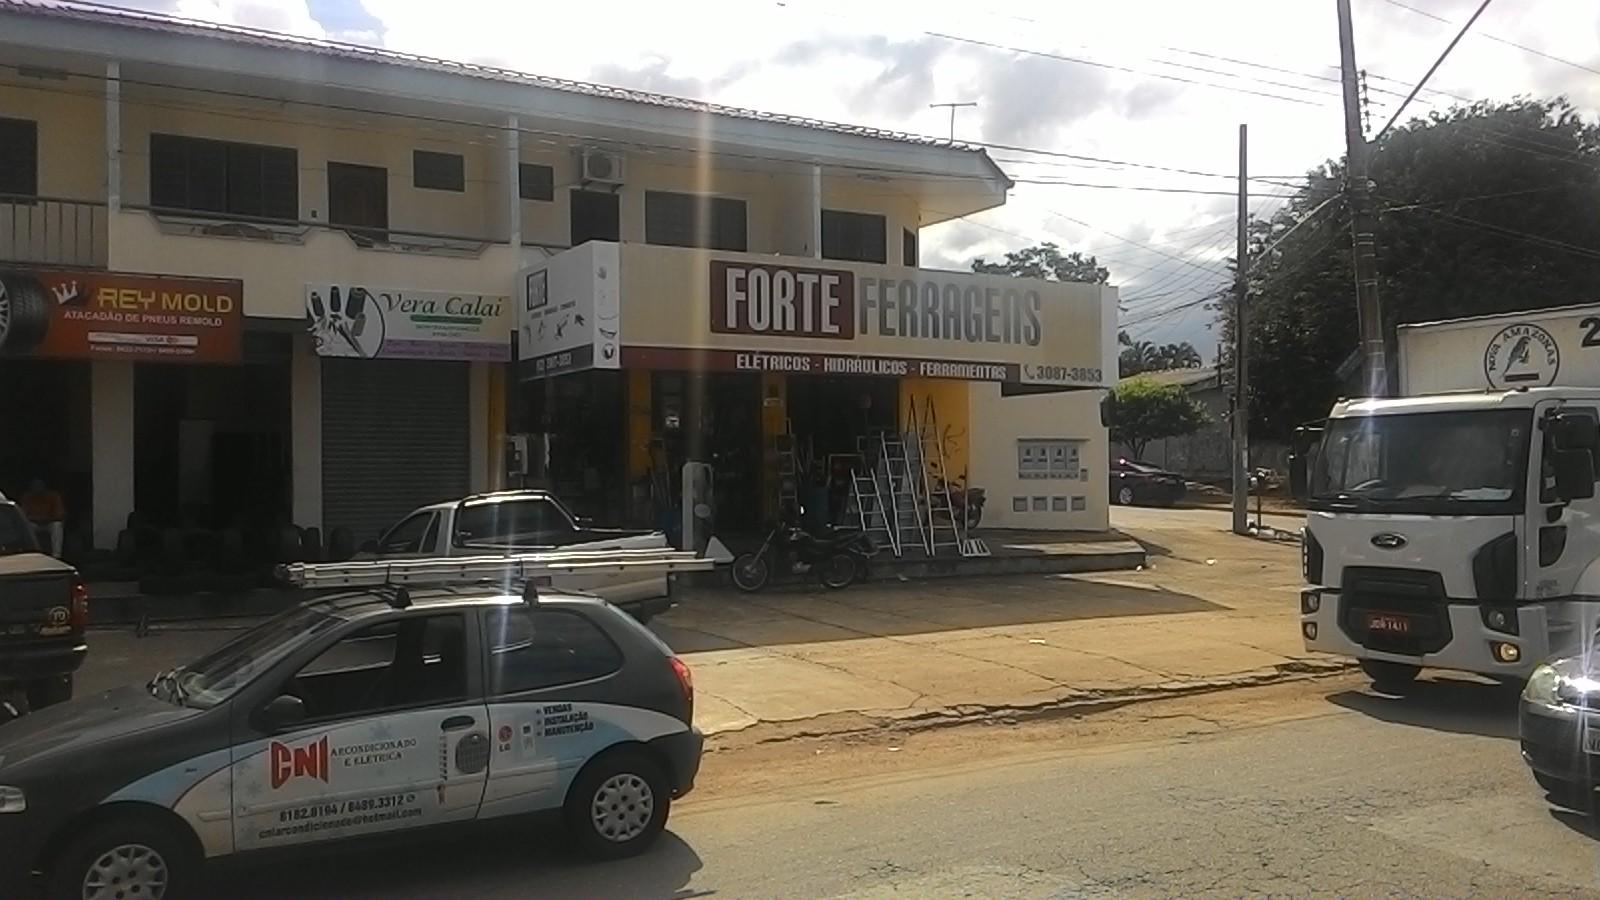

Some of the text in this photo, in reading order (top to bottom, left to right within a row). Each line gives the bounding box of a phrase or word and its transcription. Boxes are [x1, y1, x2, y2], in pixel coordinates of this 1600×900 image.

[98, 288, 233, 313] REY MOLD
[381, 292, 503, 317] Vera Calai
[726, 267, 1042, 347] FORTE FERRAGENS
[125, 313, 140, 323] DE
[142, 314, 178, 325] PNEUS
[180, 316, 222, 327] REMOLD
[1488, 327, 1556, 371] NOVA AMAZONAS
[736, 351, 810, 371] ELÉTRICOS
[824, 355, 907, 377] HIDRÁULICOS
[919, 361, 1007, 380] FERRAMENTAS
[1036, 365, 1103, 382] 3087-3853
[270, 735, 329, 790] CNI
